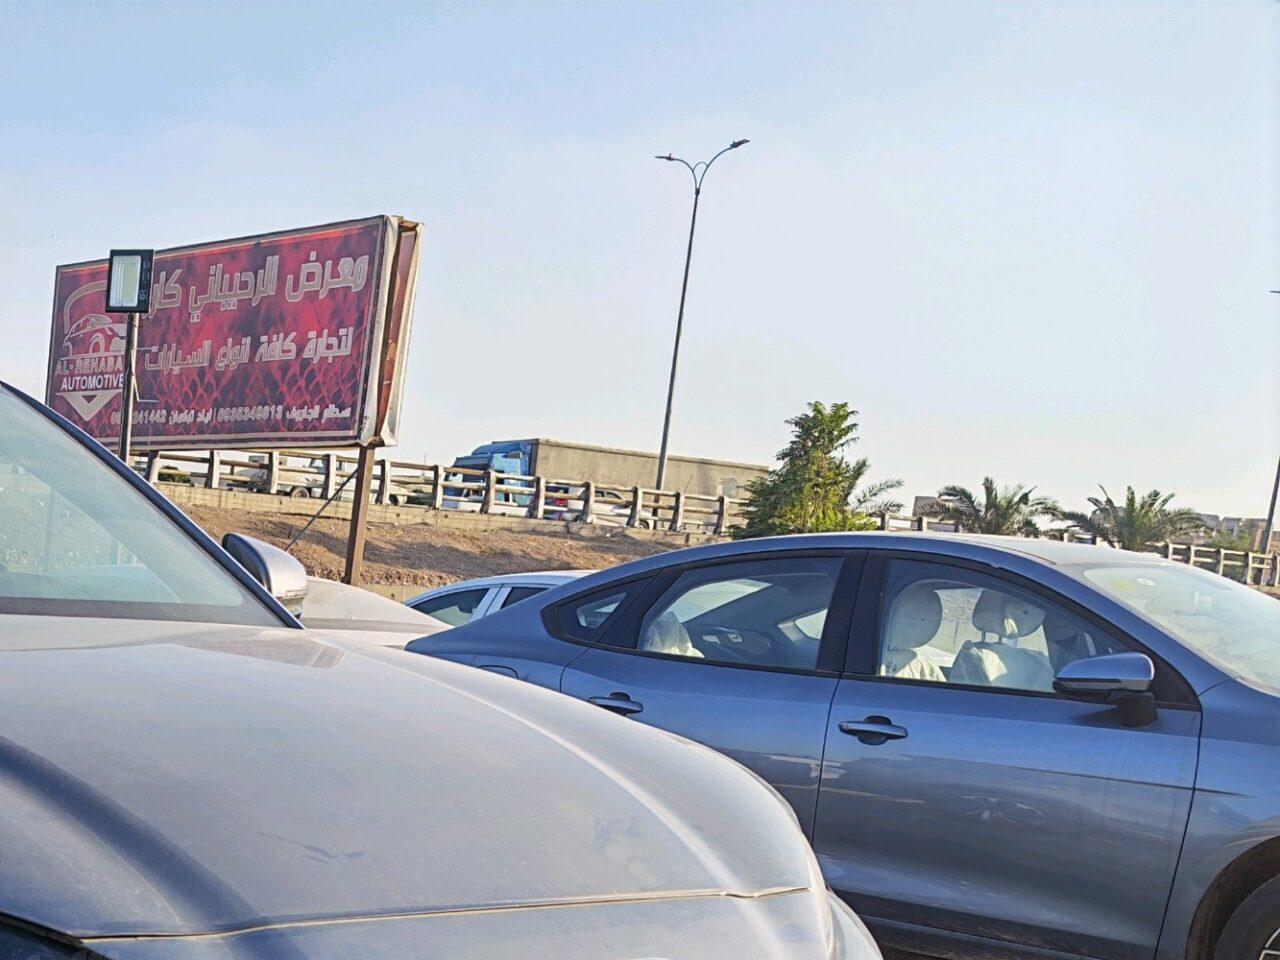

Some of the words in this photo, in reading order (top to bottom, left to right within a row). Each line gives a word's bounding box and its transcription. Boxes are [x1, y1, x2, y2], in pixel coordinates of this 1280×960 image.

[188, 255, 279, 323] الرحيباني
[285, 251, 370, 302] معرض
[145, 340, 212, 373] السيارات
[255, 332, 298, 362] كافة
[303, 326, 354, 364] لتجارة
[60, 374, 123, 391] AUTOMOTIVE
